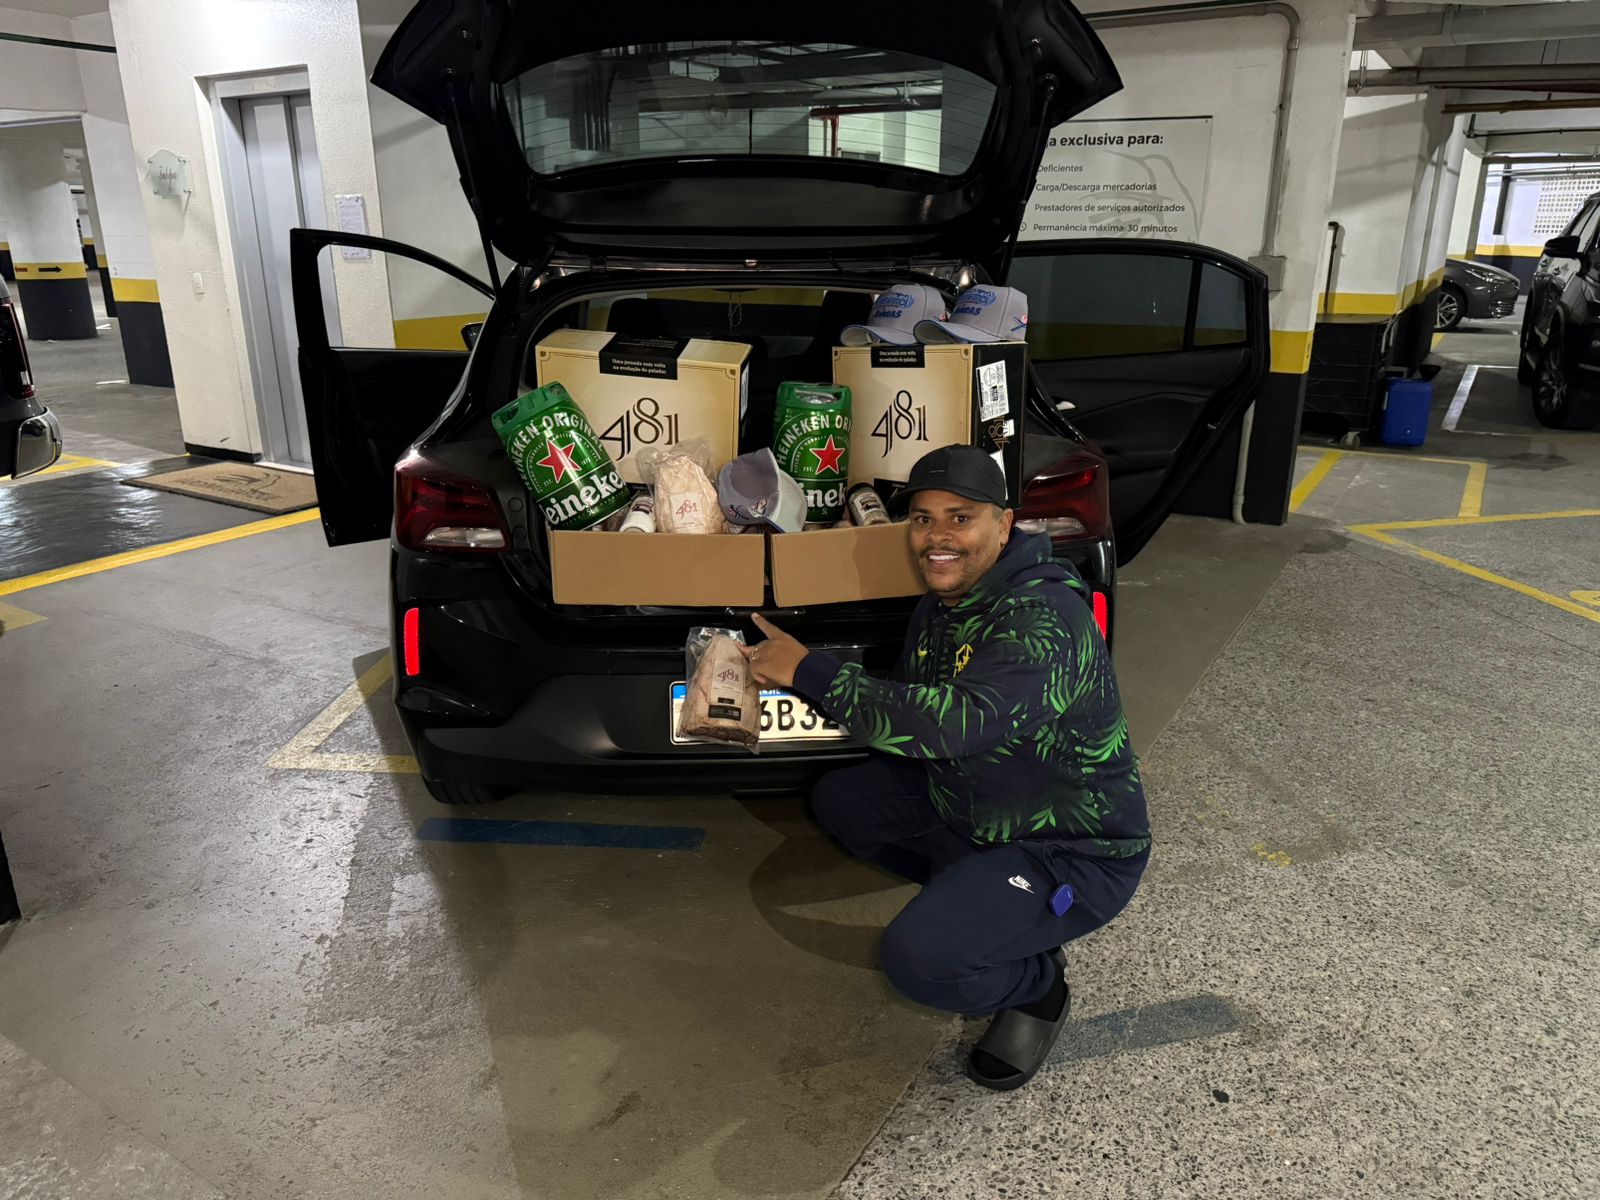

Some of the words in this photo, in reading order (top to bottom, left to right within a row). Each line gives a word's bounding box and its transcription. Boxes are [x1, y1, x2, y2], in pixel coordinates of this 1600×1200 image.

[1060, 133, 1124, 147] exclusiva
[1127, 134, 1164, 148] para:
[1037, 164, 1084, 173] Deficientes
[1035, 183, 1101, 193] Carga/Descarga
[1102, 182, 1158, 192] mercadorias
[1034, 203, 1083, 213] Prestadores
[1084, 203, 1096, 213] de
[1097, 203, 1132, 214] serviços
[1132, 203, 1186, 213] autorizados
[1032, 223, 1088, 233] Permanência
[1127, 224, 1139, 233] 30
[1140, 224, 1178, 233] minutos
[599, 397, 680, 462] 481
[871, 390, 930, 458] 481
[776, 414, 830, 466] HEINEKEN
[541, 471, 626, 526] eineke
[1013, 874, 1032, 889] NIKE
